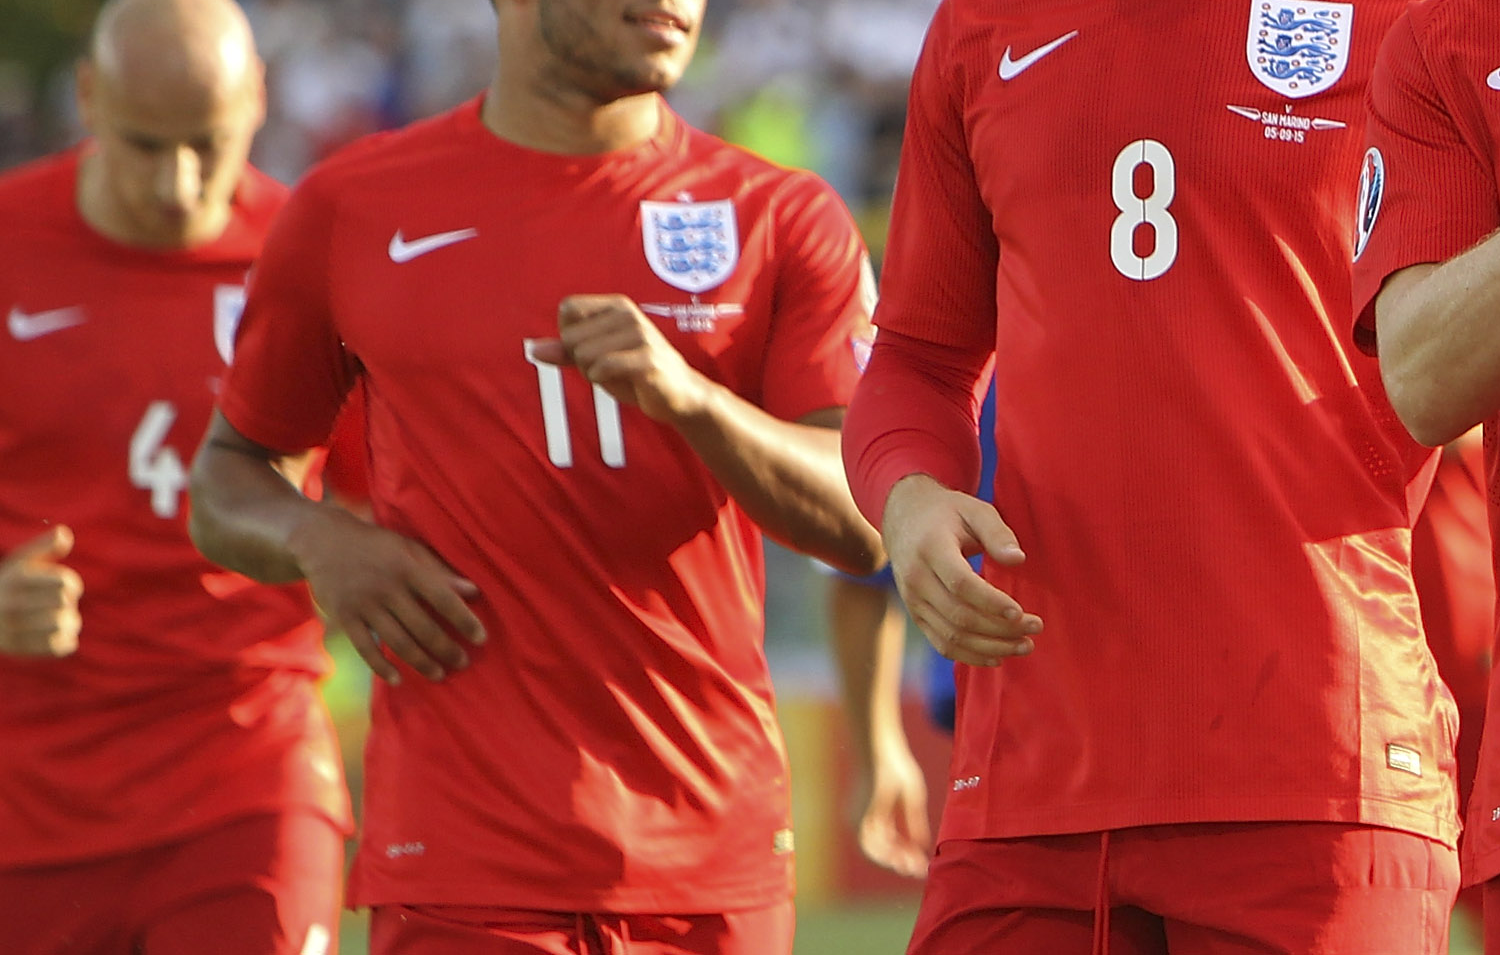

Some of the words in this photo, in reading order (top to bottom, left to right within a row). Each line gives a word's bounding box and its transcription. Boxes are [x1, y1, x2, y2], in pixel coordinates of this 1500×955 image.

[1261, 110, 1279, 126] SAN
[1279, 113, 1311, 131] MARINO
[1110, 139, 1179, 281] 8
[128, 400, 188, 517] 4
[523, 337, 627, 469] 11
